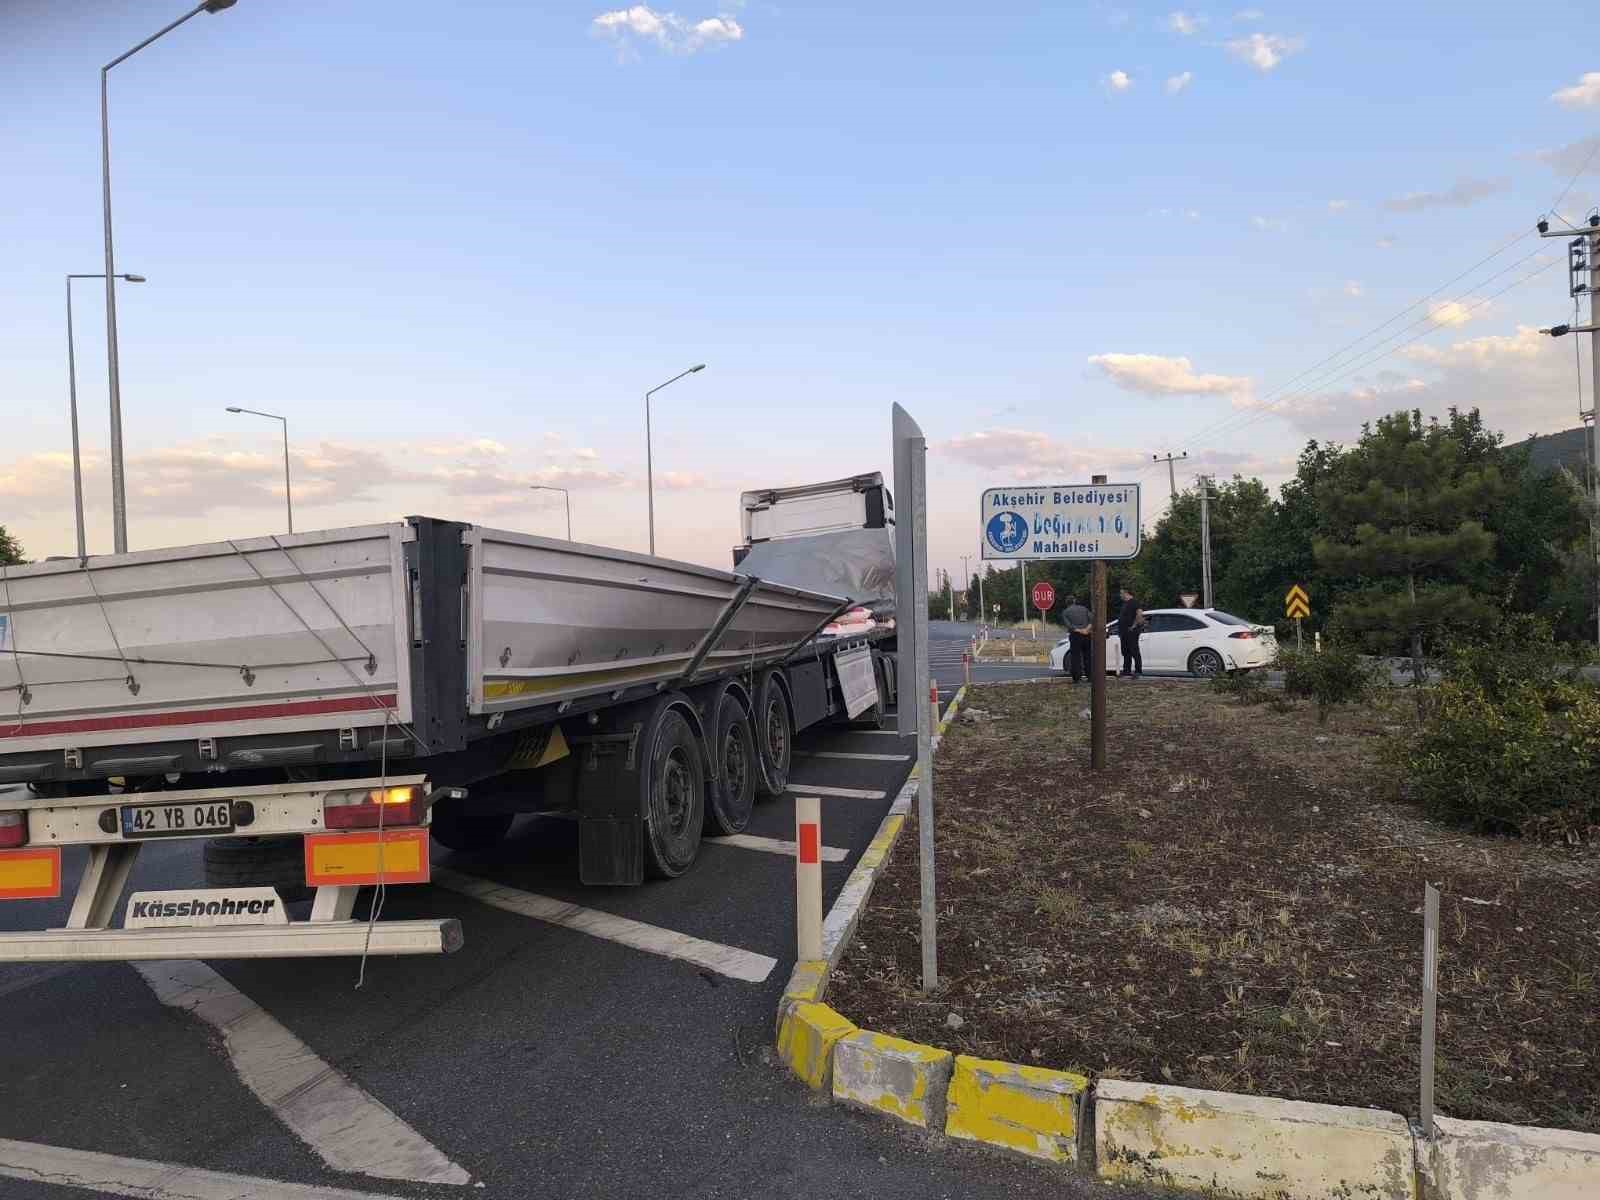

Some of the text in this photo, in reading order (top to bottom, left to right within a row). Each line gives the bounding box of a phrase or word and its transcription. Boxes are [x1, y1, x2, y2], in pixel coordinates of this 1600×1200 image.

[1053, 489, 1128, 506] Belediyesi
[1033, 539, 1099, 553] Mahallesi
[1035, 591, 1052, 600] DUR
[134, 805, 228, 830] 42 YB 046
[132, 898, 275, 918] Kässbohrer
